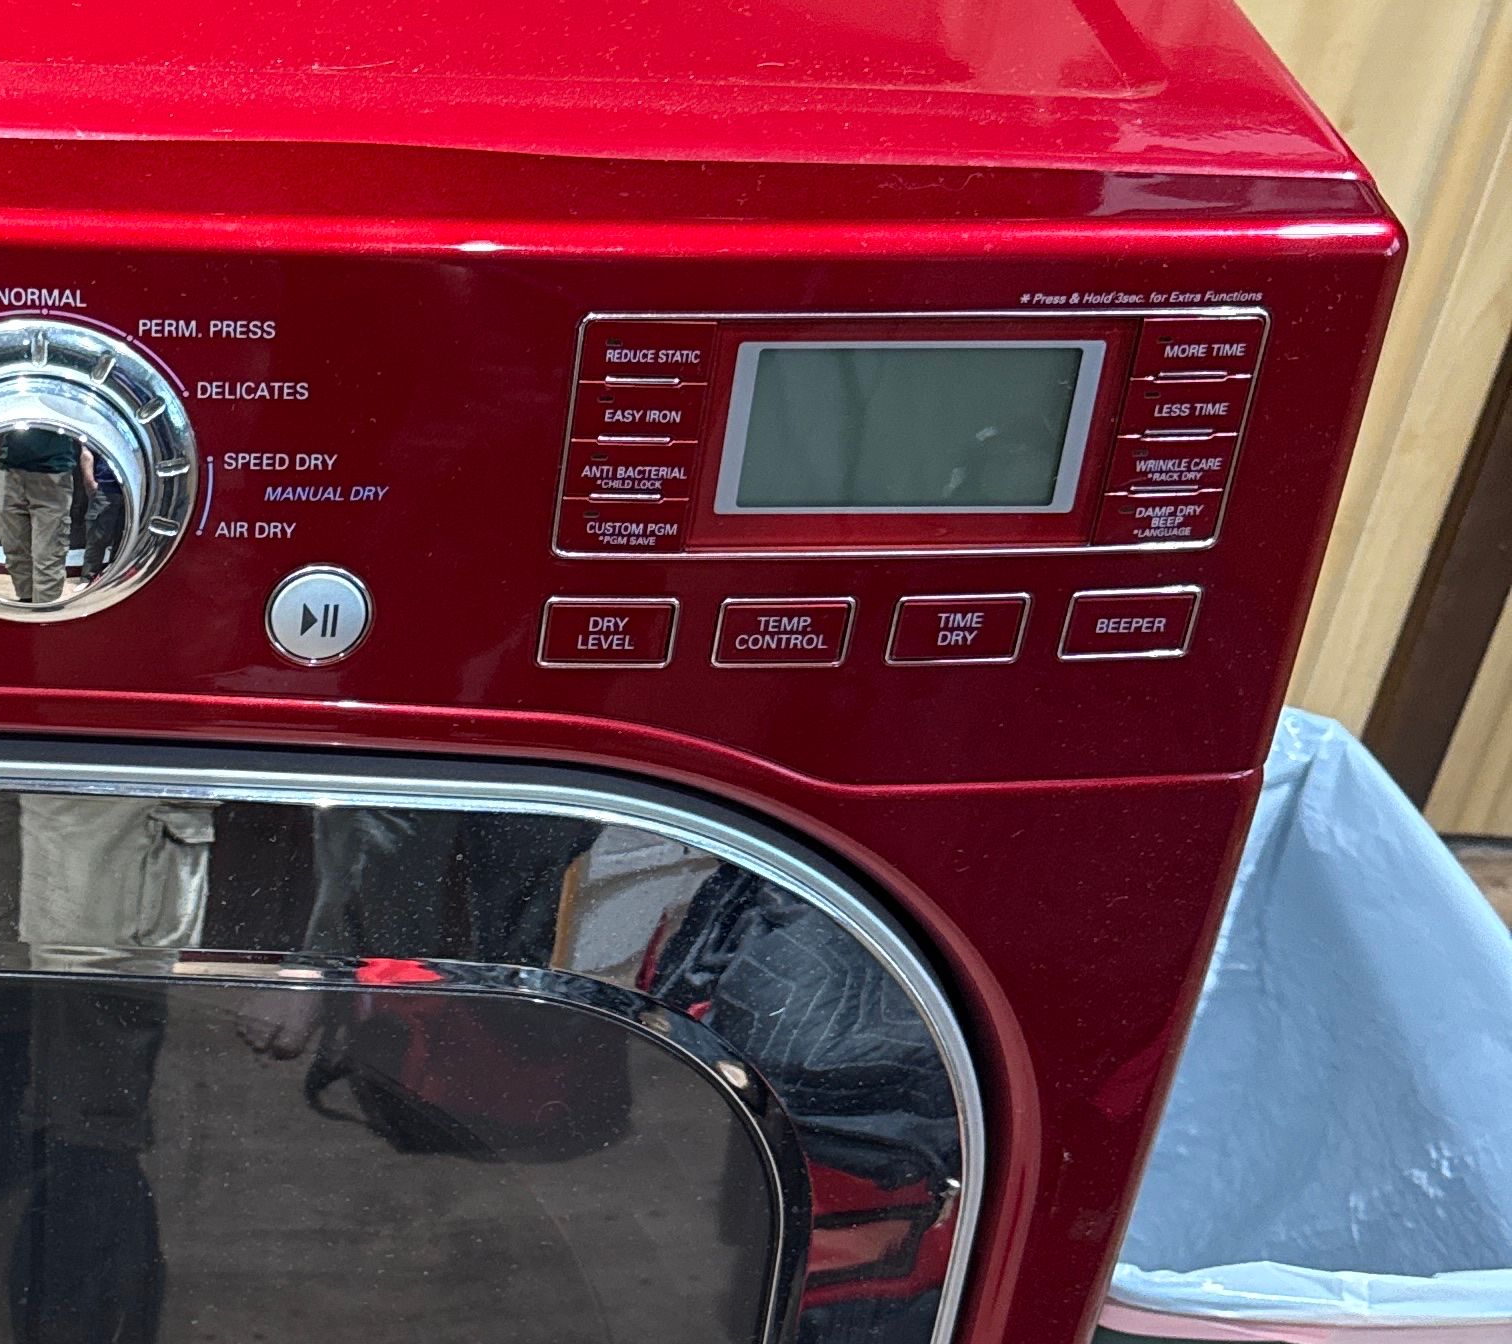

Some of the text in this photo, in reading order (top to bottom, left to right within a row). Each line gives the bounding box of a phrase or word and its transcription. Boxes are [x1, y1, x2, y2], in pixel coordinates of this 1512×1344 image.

[1033, 292, 1066, 305] Press
[1069, 292, 1080, 305] &
[1083, 291, 1113, 304] Hold
[1149, 291, 1167, 303] for
[1169, 291, 1202, 303] Extra
[1204, 290, 1263, 303] Functions
[138, 319, 276, 340] PERM. PRESS
[605, 349, 700, 364] REDUCE STATIC
[1164, 343, 1247, 358] MORE TIME
[197, 381, 309, 400] DELICATES
[604, 409, 681, 424] EASY IRON
[1154, 402, 1230, 417] LESS TIME
[223, 452, 338, 472] SPEED DRY
[1136, 458, 1223, 473] WRINKLE CARE
[581, 465, 687, 480] ANTI BACTERIAL
[1181, 472, 1203, 481] DRY
[634, 480, 663, 490] LOCK
[264, 485, 389, 502] MANUAL DRY
[1135, 504, 1204, 518] DAMP DRY
[586, 521, 678, 536] CUSTOM PGM
[1151, 517, 1184, 528] BEEP
[215, 522, 296, 539] AIR DRY
[629, 536, 656, 546] SAVE
[589, 616, 629, 632] DRY
[757, 616, 811, 632] TEMP.
[938, 612, 985, 628] TIME
[1095, 617, 1166, 633] BEEPER
[576, 635, 635, 650] LEVEL
[735, 634, 828, 650] CONTROL
[937, 631, 978, 646] DRY
